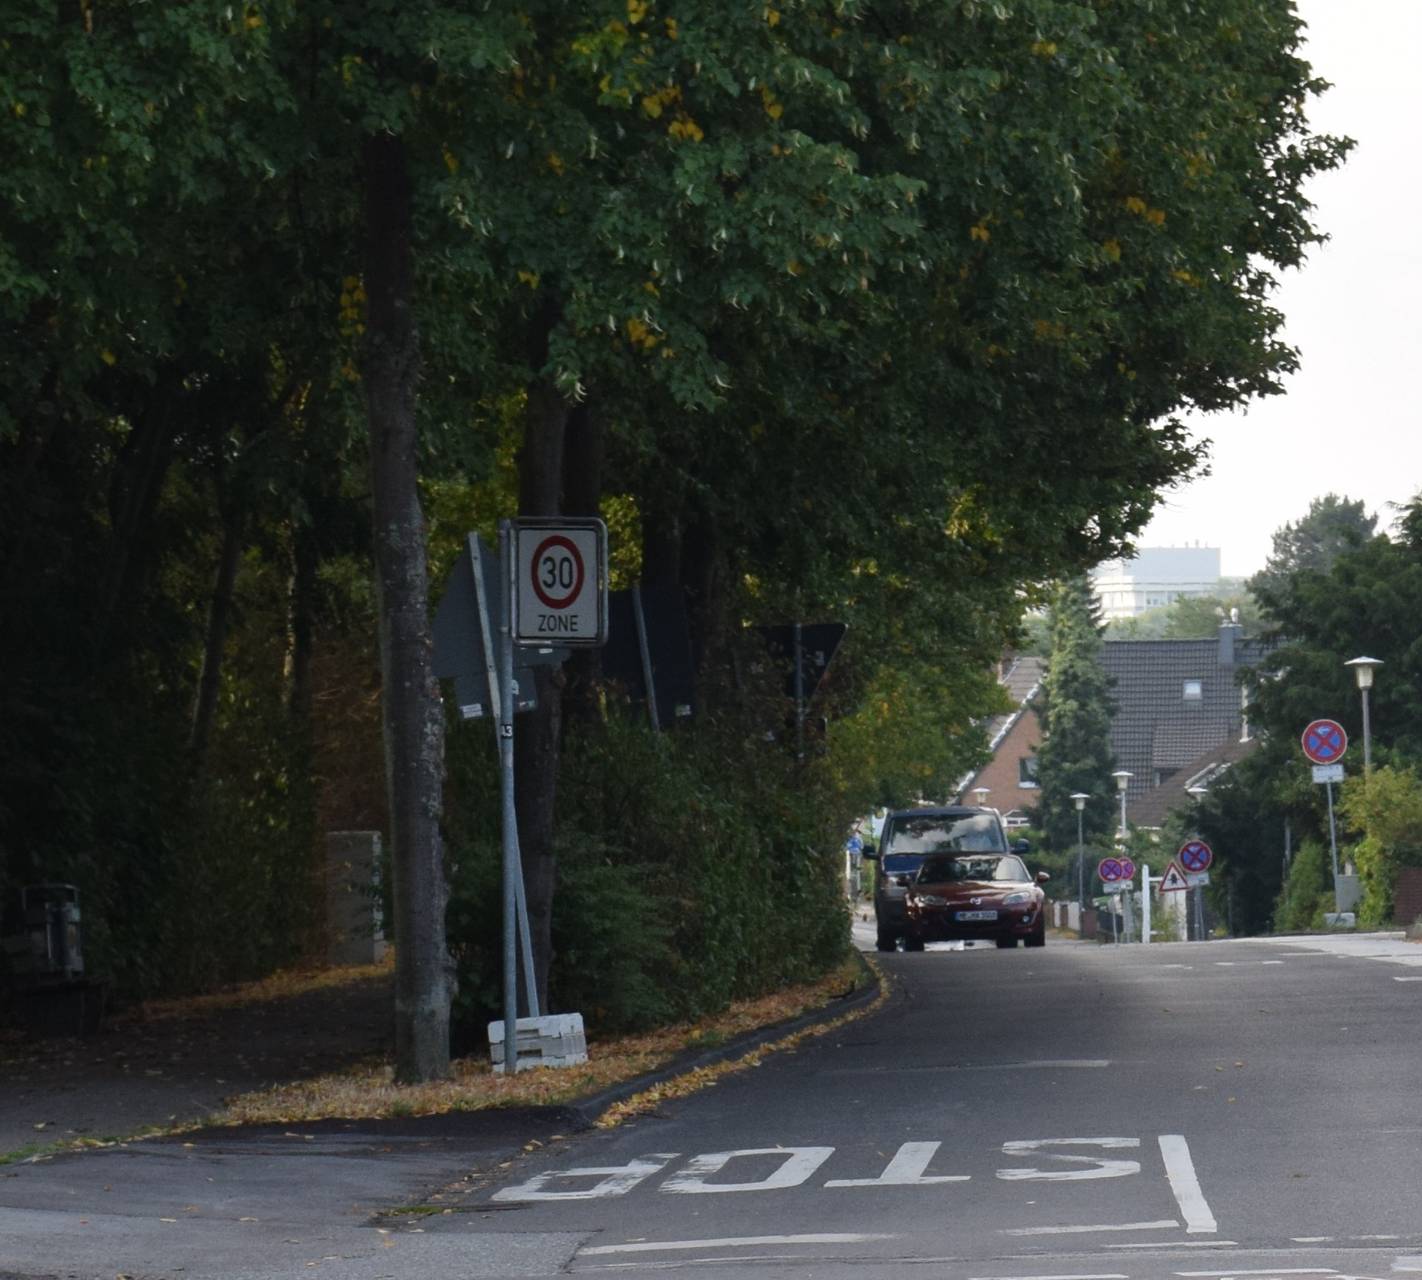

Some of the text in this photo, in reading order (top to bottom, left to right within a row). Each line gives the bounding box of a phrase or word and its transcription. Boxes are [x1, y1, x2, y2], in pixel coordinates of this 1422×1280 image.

[542, 556, 574, 589] 30
[537, 614, 579, 632] ZONE
[490, 1136, 1141, 1201] STOP
